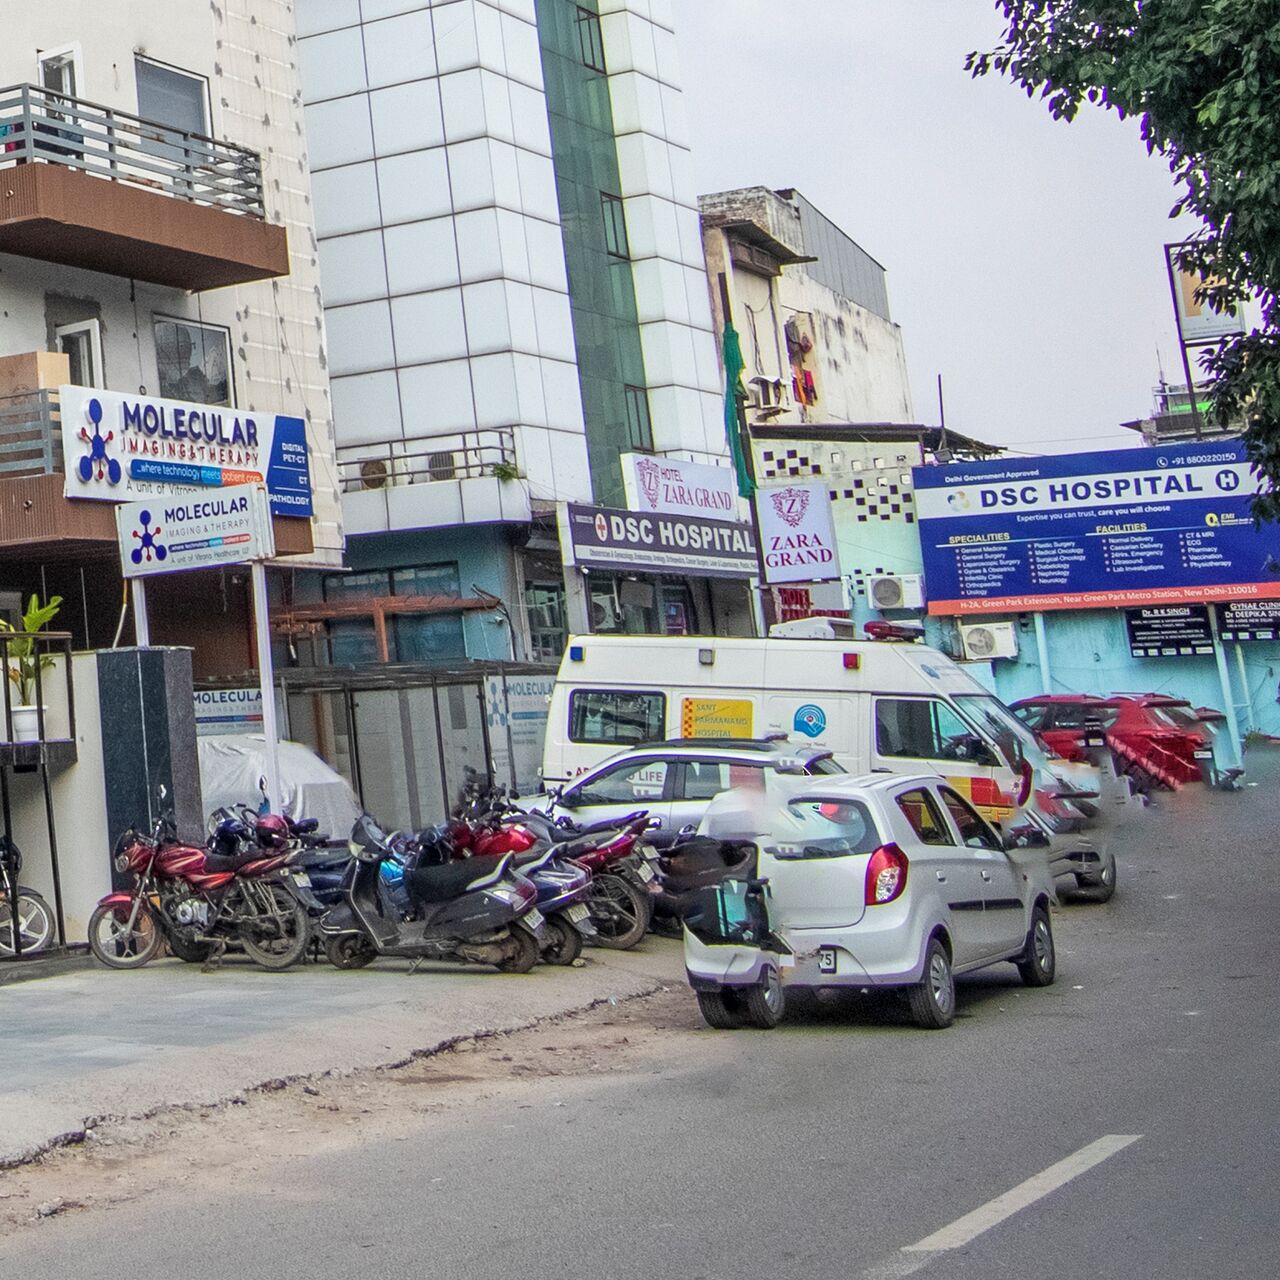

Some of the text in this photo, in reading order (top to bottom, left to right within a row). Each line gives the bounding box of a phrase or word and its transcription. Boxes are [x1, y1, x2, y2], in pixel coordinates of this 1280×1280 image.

[121, 401, 259, 449] MOLECULAR
[282, 442, 305, 454] DIGITAL
[283, 454, 306, 464] PET-CT
[162, 464, 200, 481] technology
[201, 470, 221, 480] meets
[222, 471, 247, 483] patient
[298, 476, 308, 485] CT
[660, 468, 683, 483] HOTEL
[944, 469, 1040, 484] Delhi Government Approved
[126, 480, 133, 492] A
[136, 482, 153, 493] unit
[157, 483, 166, 495] of
[981, 487, 1038, 508] DSC
[1049, 474, 1203, 503] HOSPITAL
[268, 494, 310, 505] PATHOLOGY
[663, 483, 732, 511] ZARA GRAND
[164, 496, 249, 524] MOLECULAR
[1016, 512, 1048, 523] Expertise
[1049, 513, 1063, 521] you
[1078, 509, 1097, 519] trust,
[1098, 509, 1113, 517] care
[1114, 508, 1128, 517] you
[1129, 505, 1143, 514] will
[1144, 504, 1171, 514] choose
[166, 525, 202, 538] IMAGING
[210, 518, 250, 532] THERAPY
[610, 515, 757, 554] DSC HOSPITAL
[1095, 523, 1148, 534] FACILITIES
[770, 533, 824, 551] ZARA
[949, 532, 1011, 544] SPECIALITIES
[765, 548, 833, 568] GRAND
[960, 600, 981, 610] H-2A,
[982, 598, 1005, 608] Green
[1006, 597, 1023, 607] Park
[1023, 596, 1062, 606] Extension,
[1064, 594, 1084, 603] Near
[1084, 593, 1107, 602] Green
[1107, 592, 1125, 601] Park
[1126, 590, 1151, 600] Metro
[1152, 588, 1183, 599] Station,
[1184, 588, 1202, 597] New
[1166, 607, 1190, 616] SINGH
[1235, 610, 1267, 618] DEEPIKA
[508, 682, 554, 696] MOLECULA
[193, 690, 263, 704] MOLECULA
[696, 703, 717, 712] SANT
[694, 729, 732, 737] HOSPITAL
[639, 771, 663, 782] LIFE
